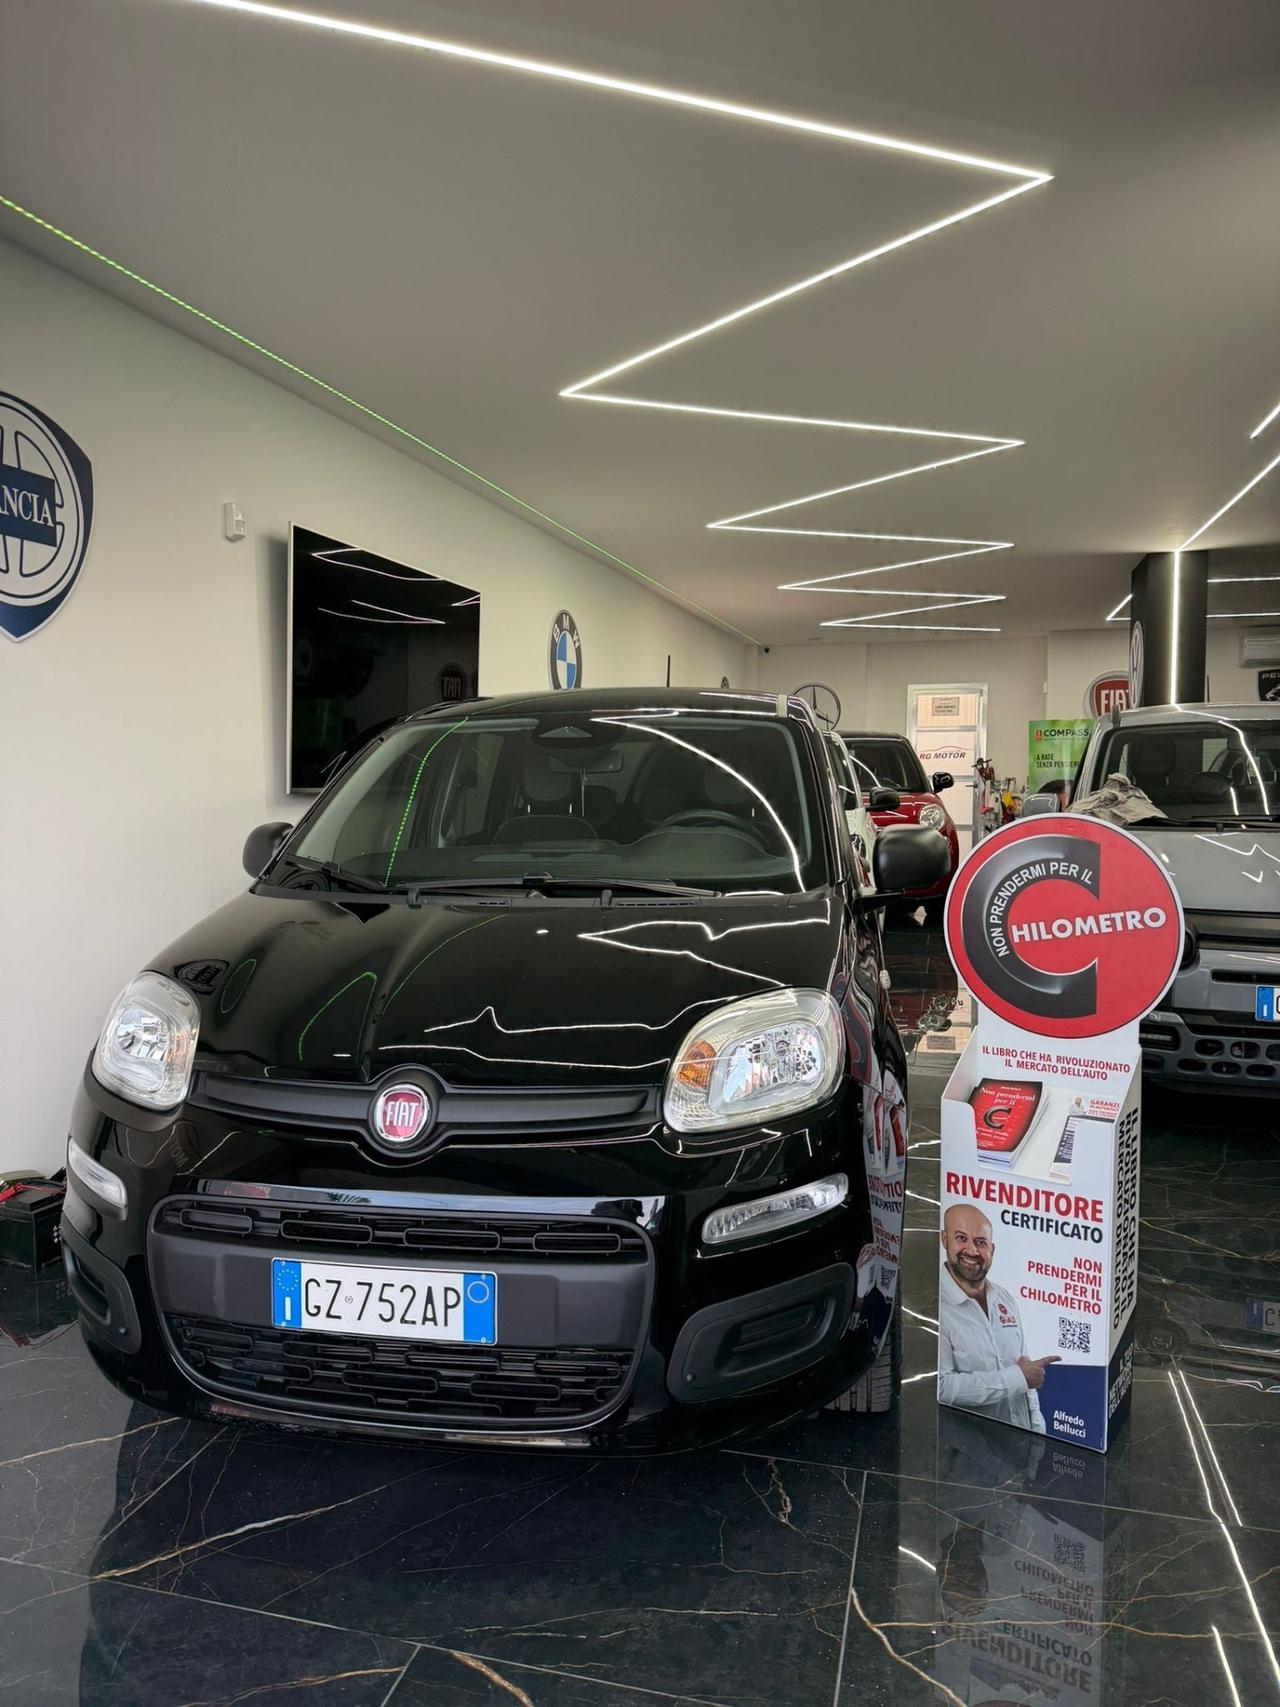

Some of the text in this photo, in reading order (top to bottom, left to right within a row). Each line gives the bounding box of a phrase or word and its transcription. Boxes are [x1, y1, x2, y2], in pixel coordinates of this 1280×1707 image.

[0, 485, 54, 527] NCIA
[553, 614, 580, 648] BMW
[1101, 689, 1129, 716] FIA
[1044, 729, 1089, 737] COMPASS
[990, 862, 1093, 957] NON PRENDERMI PER IL
[1011, 907, 1166, 943] HILOMETRO
[982, 1045, 1131, 1073] IL LIBRO CHE HA RIVOLUZIONATO
[1005, 1058, 1108, 1081] IL MERCATO DELL'AUTO
[386, 1101, 421, 1128] FIAT
[946, 1172, 1104, 1223] RIVENDITORE
[1127, 1107, 1138, 1309] IL LIBRO CHE HA
[1000, 1209, 1104, 1244] CERTIFICATO
[1113, 1120, 1125, 1329] MERCATO DELL'AUTO
[1121, 1112, 1132, 1320] RIVOLUZIONATO IL
[1028, 1260, 1102, 1288] PRENDERMI
[1074, 1257, 1102, 1273] NON
[1020, 1286, 1102, 1315] CHILOMETRO
[1064, 1282, 1102, 1301] PER IL
[1053, 1410, 1084, 1427] Alfredo
[1053, 1421, 1086, 1438] Bellucci
